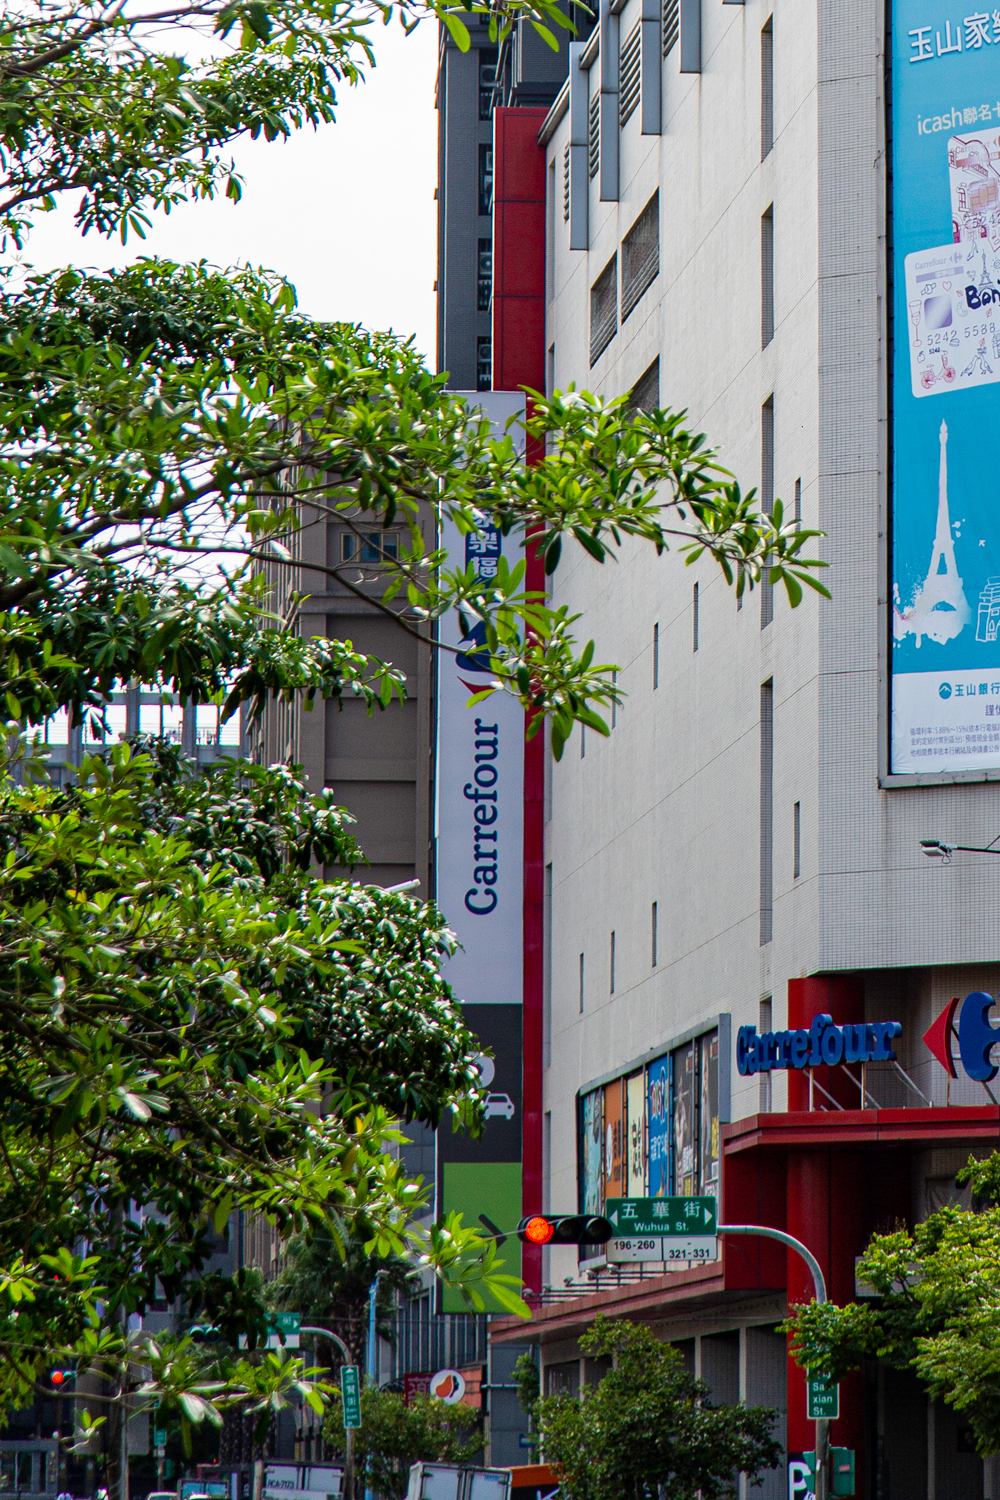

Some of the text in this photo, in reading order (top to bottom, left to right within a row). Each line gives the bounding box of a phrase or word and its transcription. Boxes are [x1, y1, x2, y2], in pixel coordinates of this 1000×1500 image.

[914, 256, 947, 270] Carrefour
[927, 329, 957, 346] 5242
[954, 682, 1000, 697] 玉山銀行
[463, 717, 499, 916] Carrefour
[736, 1013, 902, 1076] Carrefour
[621, 1201, 701, 1219] 五華街
[634, 1221, 689, 1232] Wuhua St.
[614, 1240, 656, 1250] 196-260
[669, 1248, 710, 1259] 321-331
[813, 1394, 833, 1404] xian
[813, 1406, 827, 1416] St.
